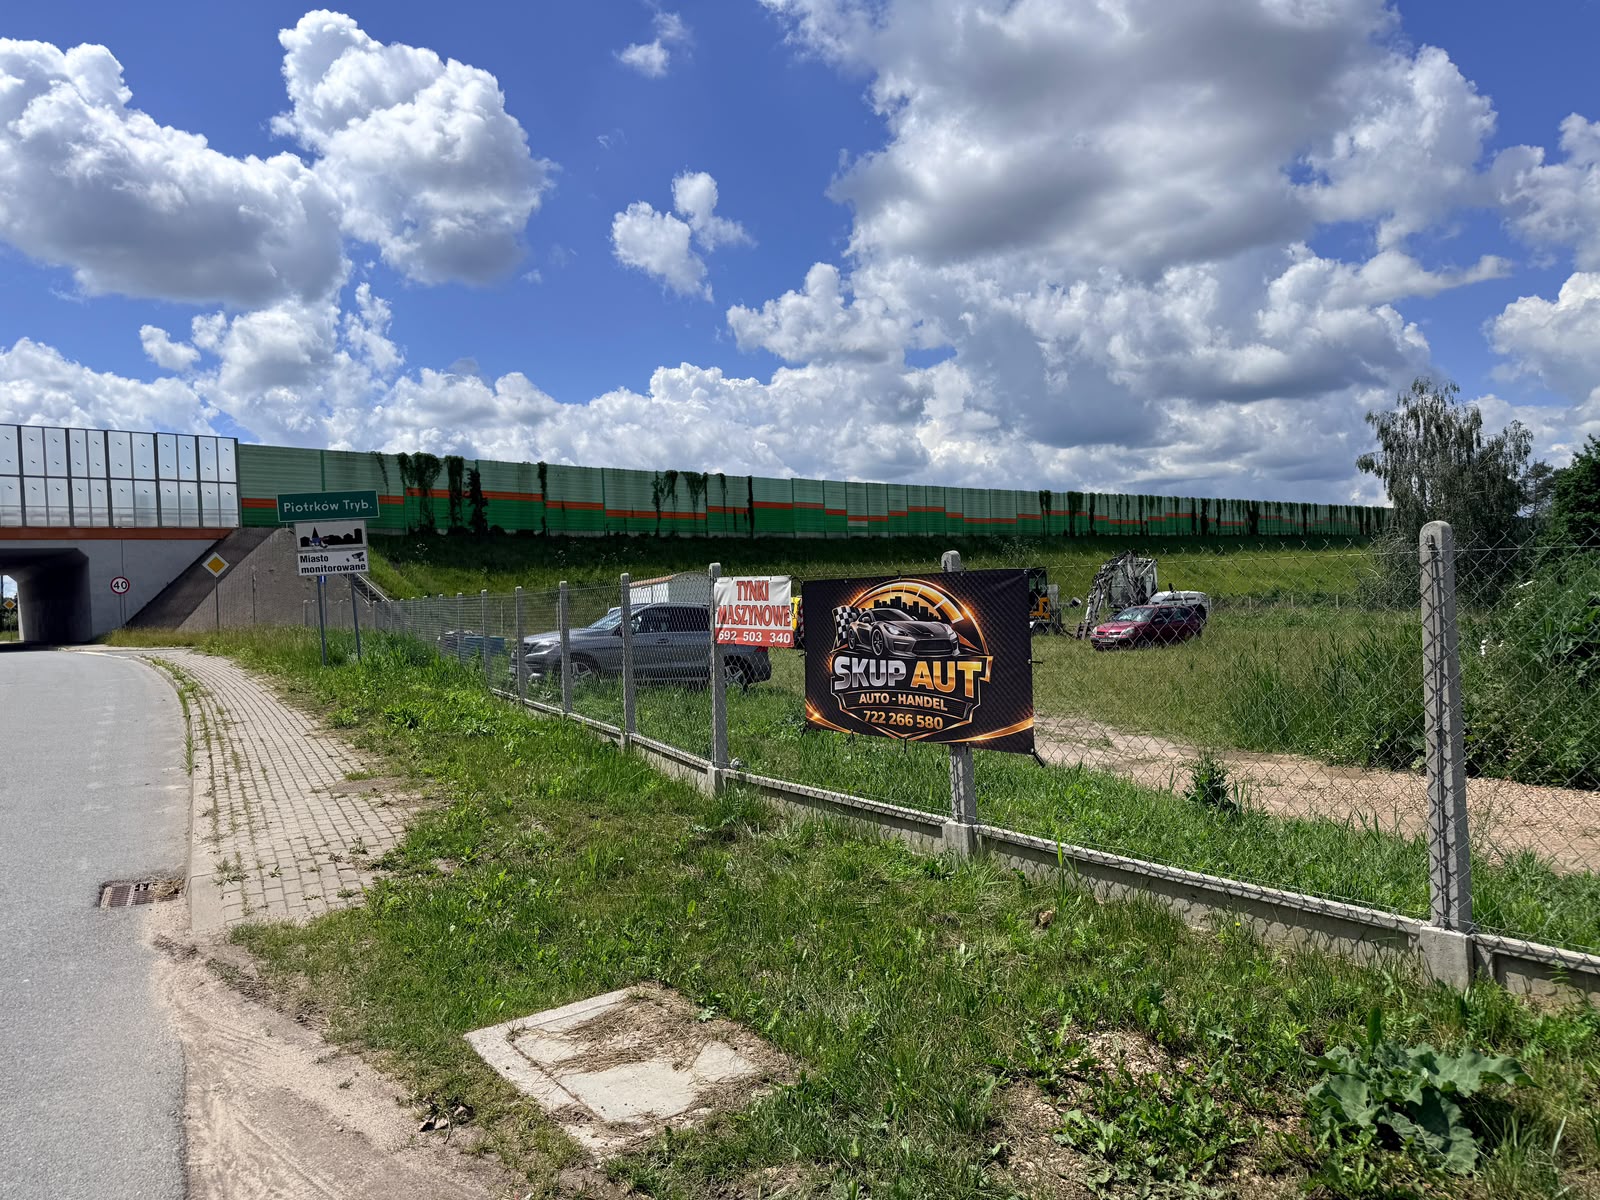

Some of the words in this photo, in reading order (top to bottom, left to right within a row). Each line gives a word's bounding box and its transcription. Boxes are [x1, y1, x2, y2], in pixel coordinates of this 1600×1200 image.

[283, 501, 339, 513] Piotrków
[342, 499, 373, 512] Tryb.
[300, 555, 329, 563] Miasto
[301, 563, 366, 574] monitorowane
[113, 581, 128, 590] 40
[736, 580, 769, 601] TYNKI
[716, 604, 791, 627] MASZYNOWE
[718, 630, 737, 641] 692
[743, 631, 763, 642] 503
[769, 632, 791, 643] 340
[834, 656, 907, 690] SKUP
[910, 660, 982, 699] AUT
[858, 692, 890, 705] AUTO
[898, 694, 948, 712] HANDEL
[863, 710, 886, 724] 722
[888, 712, 914, 727] 266
[916, 715, 944, 730] 580
